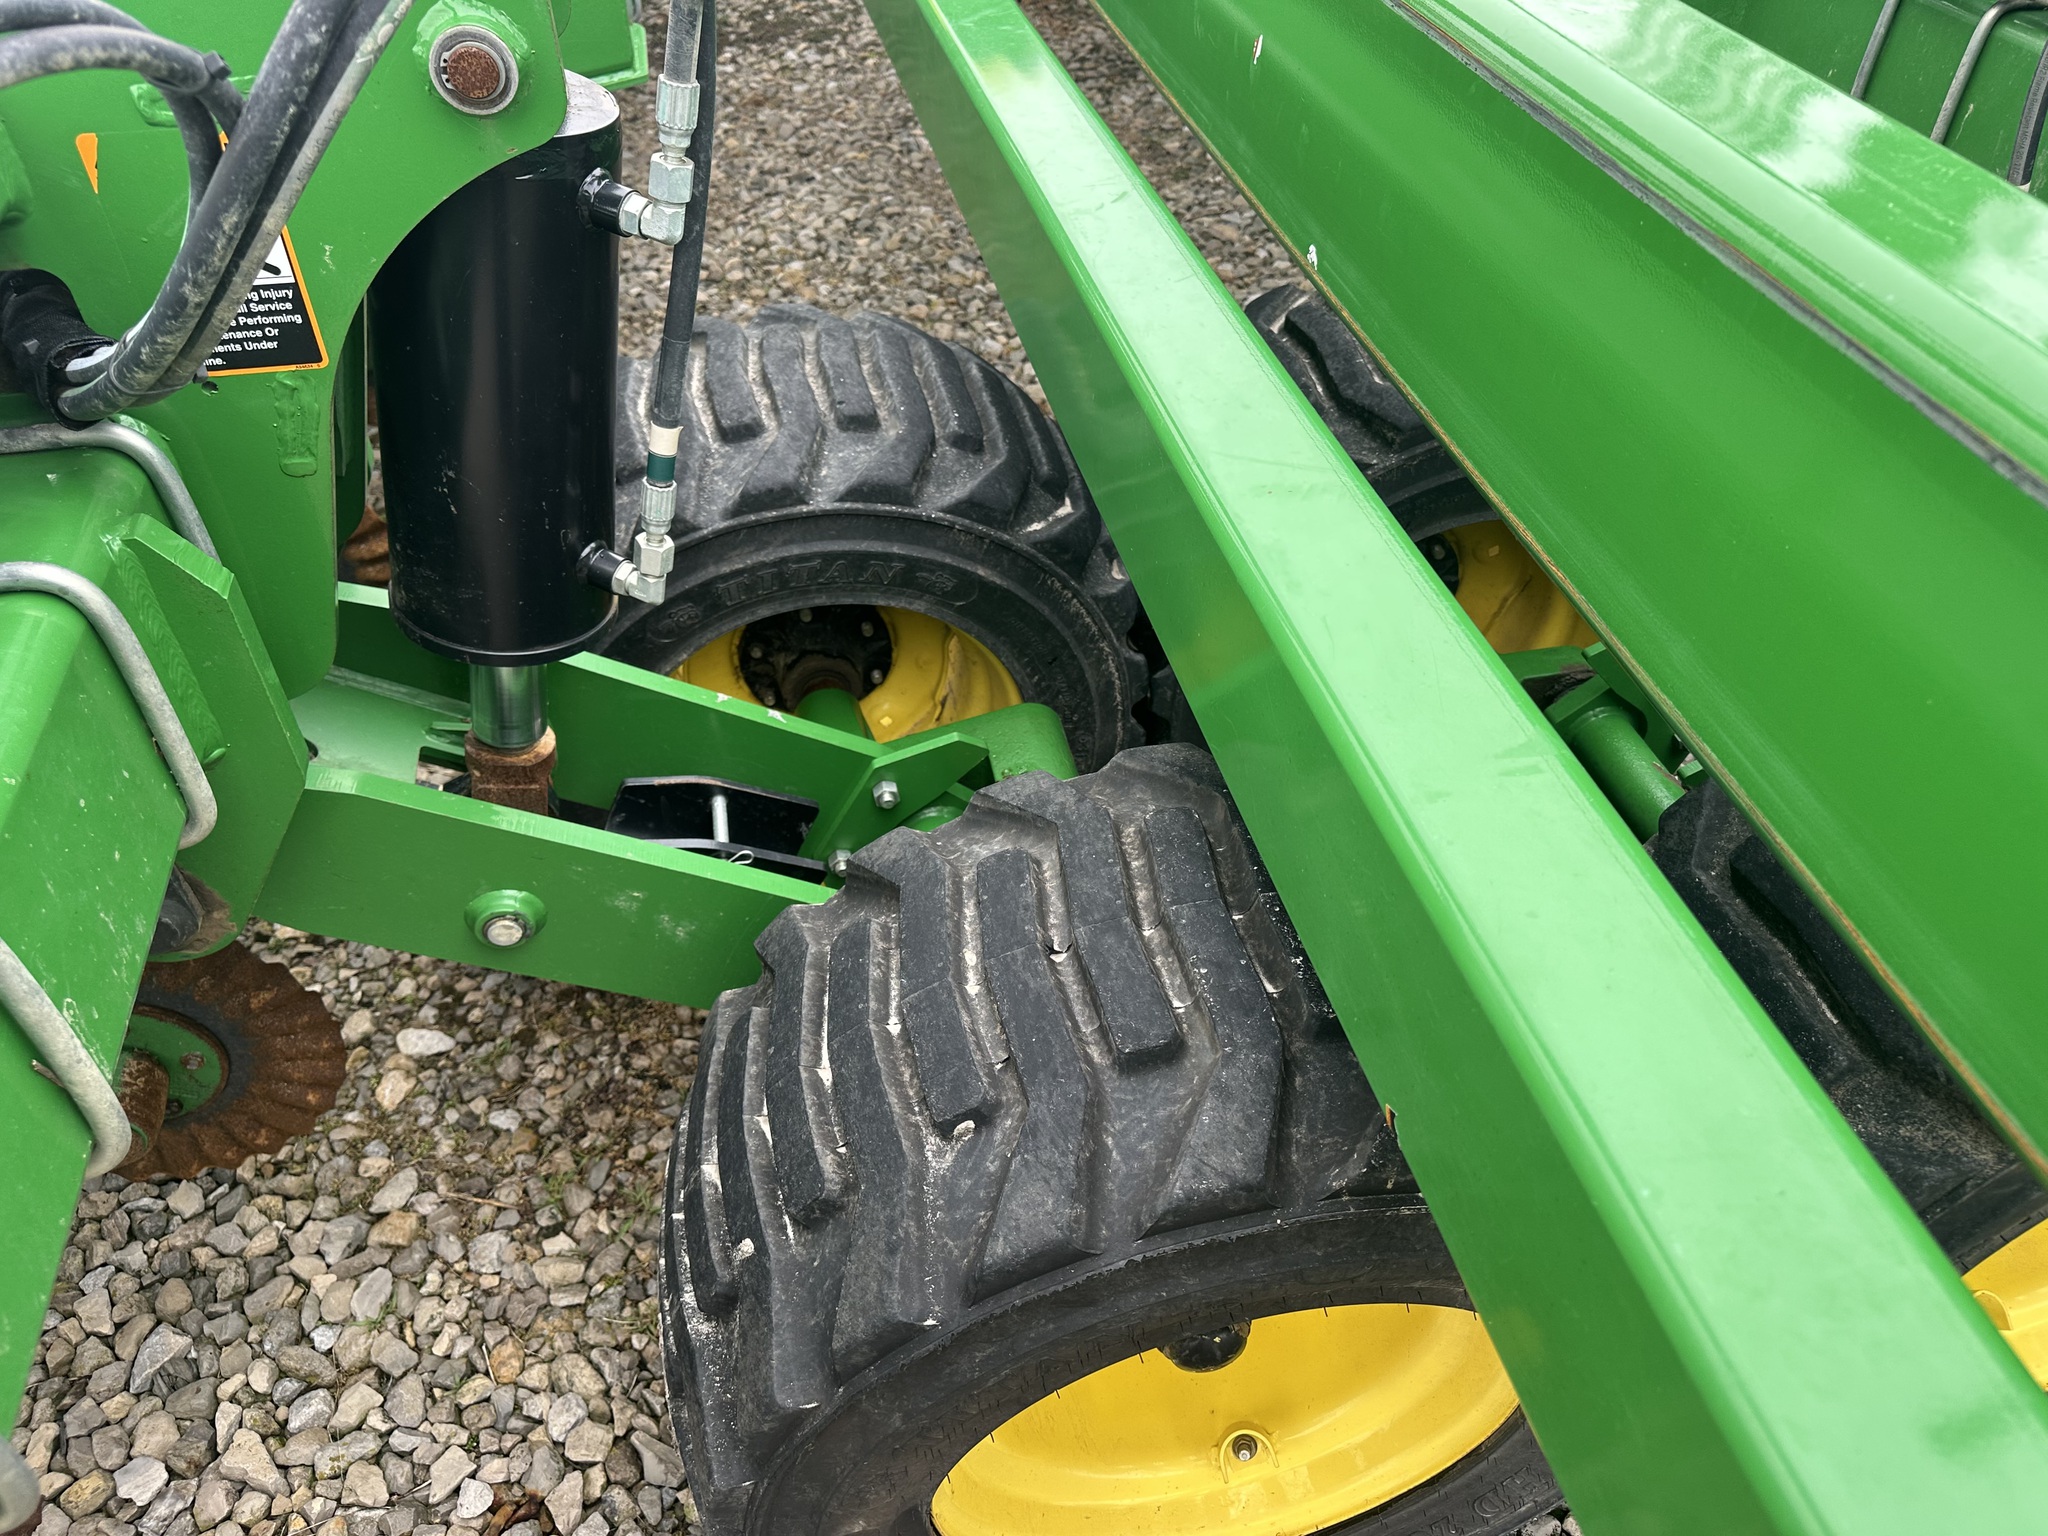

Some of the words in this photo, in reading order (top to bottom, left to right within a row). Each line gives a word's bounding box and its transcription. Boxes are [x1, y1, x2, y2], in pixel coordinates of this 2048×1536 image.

[260, 288, 293, 300] Injury
[250, 301, 293, 312] Service
[238, 313, 303, 326] Performing
[221, 330, 263, 340] enance
[264, 327, 279, 337] Or
[244, 340, 278, 351] Under
[714, 559, 906, 607] TITAN
